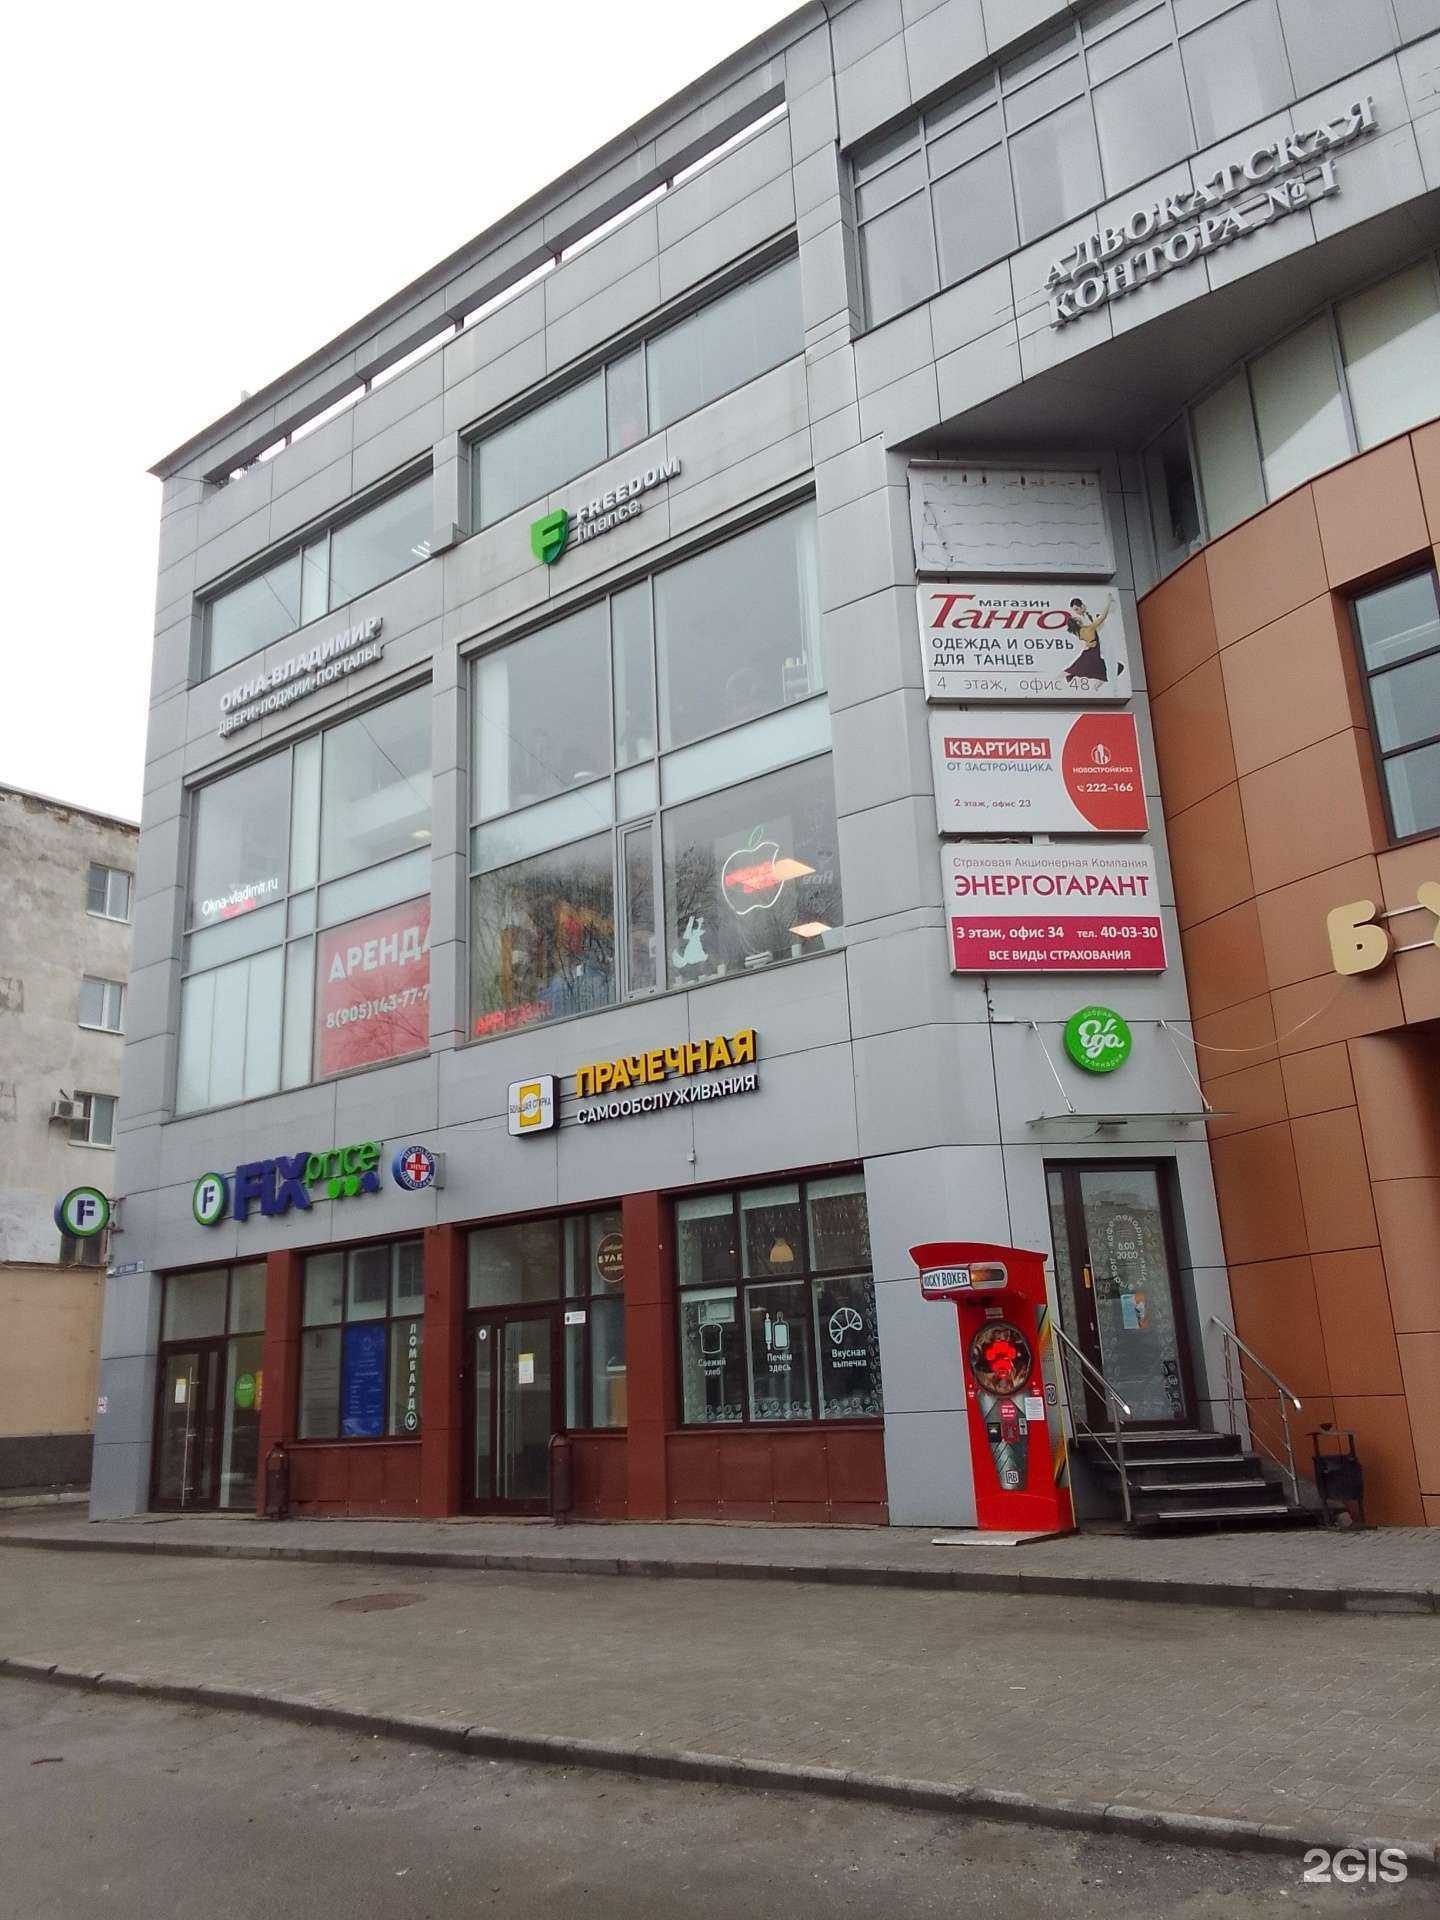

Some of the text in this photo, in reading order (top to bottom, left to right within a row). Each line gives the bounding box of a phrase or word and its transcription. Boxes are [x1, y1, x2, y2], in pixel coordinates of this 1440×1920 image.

[1044, 96, 1379, 289] АДВОКАТСКАЯ
[1050, 205, 1252, 329] КОНТОРА
[576, 456, 682, 524] FREEDOM
[979, 598, 1050, 608] магазин
[930, 594, 1072, 630] Танго
[932, 638, 1074, 651] ОДЕЖДА И ОБУВЬ
[934, 653, 1034, 667] ДЛЯ ТАНЦЕВ
[937, 676, 1089, 695] 4 этаж, офис 48
[949, 741, 1047, 756] КВАРТИРЫ
[946, 760, 1054, 773] ОТ ЗАСТРОЙЩИКА
[954, 799, 1032, 809] 2 этаж, офис 23
[953, 857, 1148, 869] Страховая Акционерная Компания
[954, 875, 1149, 897] ЭНЕРГОГАРАНТ
[956, 926, 1158, 940] 3 этаж, офис 34 тел. 40-03-30
[989, 950, 1132, 962] ВСЕ ВИДЫ СТРАХОВАНИЯ
[575, 1028, 757, 1098] ПРАЧЕЧНАЯ
[577, 1074, 757, 1125] САМООБСЛУЖИВАНИЯ
[305, 1141, 381, 1189] price
[941, 1270, 968, 1287] BOXER
[767, 1352, 793, 1362] Печём
[832, 1349, 867, 1359] Вкусная
[408, 1323, 417, 1411] ЛОМБАРД
[768, 1364, 792, 1374] здесь
[833, 1360, 867, 1368] выпечка
[704, 1367, 721, 1376] хлеб
